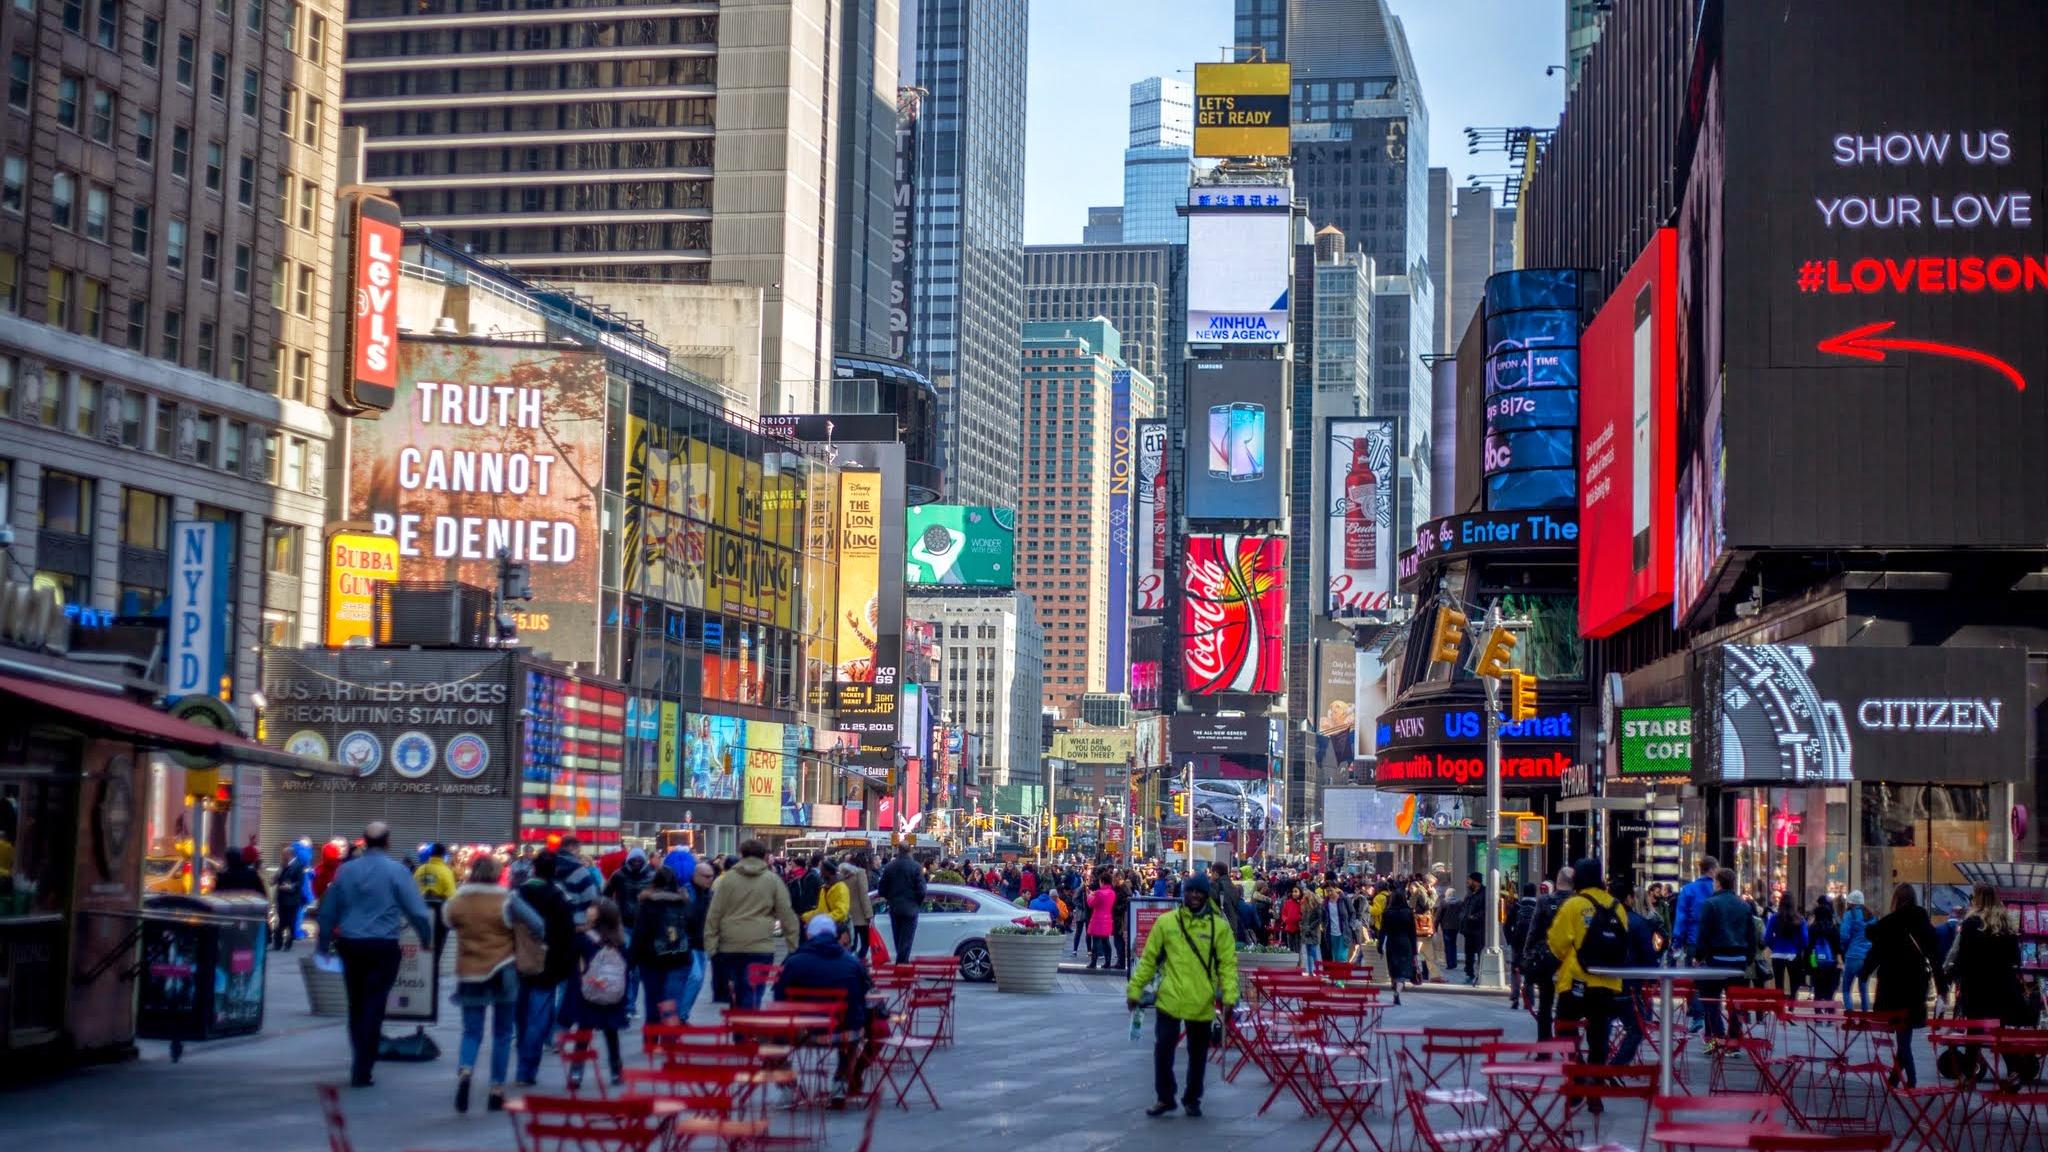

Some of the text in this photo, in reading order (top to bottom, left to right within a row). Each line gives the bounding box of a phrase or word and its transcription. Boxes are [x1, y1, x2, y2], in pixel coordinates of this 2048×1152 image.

[1199, 97, 1235, 110] LET'S
[1199, 111, 1271, 124] GET READY
[1834, 130, 2012, 163] SHOW US
[892, 130, 911, 263] TIMES
[1198, 194, 1280, 207] 新华通讯社
[1815, 194, 2033, 227] YOUR LOVE
[1797, 254, 2048, 293] #LOVEISON
[1210, 316, 1267, 329] XINHUA
[1196, 330, 1280, 340] NEWS AGENCY
[1497, 356, 1559, 371] UPON A TIME
[416, 381, 542, 430] TRUTH
[399, 447, 555, 496] CANNOT
[850, 501, 870, 509] THE
[846, 512, 874, 528] LION
[1462, 515, 1578, 544] Enter The
[435, 515, 577, 563] DENIED
[843, 530, 877, 549] KING
[335, 544, 394, 571] BUBBA
[710, 518, 788, 598] LION KING
[180, 528, 206, 690] NYPD
[1185, 552, 1225, 680] Coca-Cola
[319, 681, 409, 703] ARMED
[410, 682, 507, 704] FORCES
[284, 705, 494, 726] RECRUITING STATION
[1444, 711, 1481, 738] US
[1857, 698, 2003, 730] CITIZEN
[852, 723, 867, 731] 25,
[869, 723, 894, 731] 2015
[1400, 716, 1424, 739] NEWS
[1624, 719, 1692, 738] STARB
[750, 750, 776, 769] AERO
[868, 766, 889, 775] GARDEN
[1405, 754, 1432, 778] with
[1437, 754, 1484, 784] logo
[282, 780, 491, 794] ARMY NAVY AIR FORCE MARINES
[750, 777, 774, 794] NOW.
[1561, 763, 1589, 798] SEPHORA
